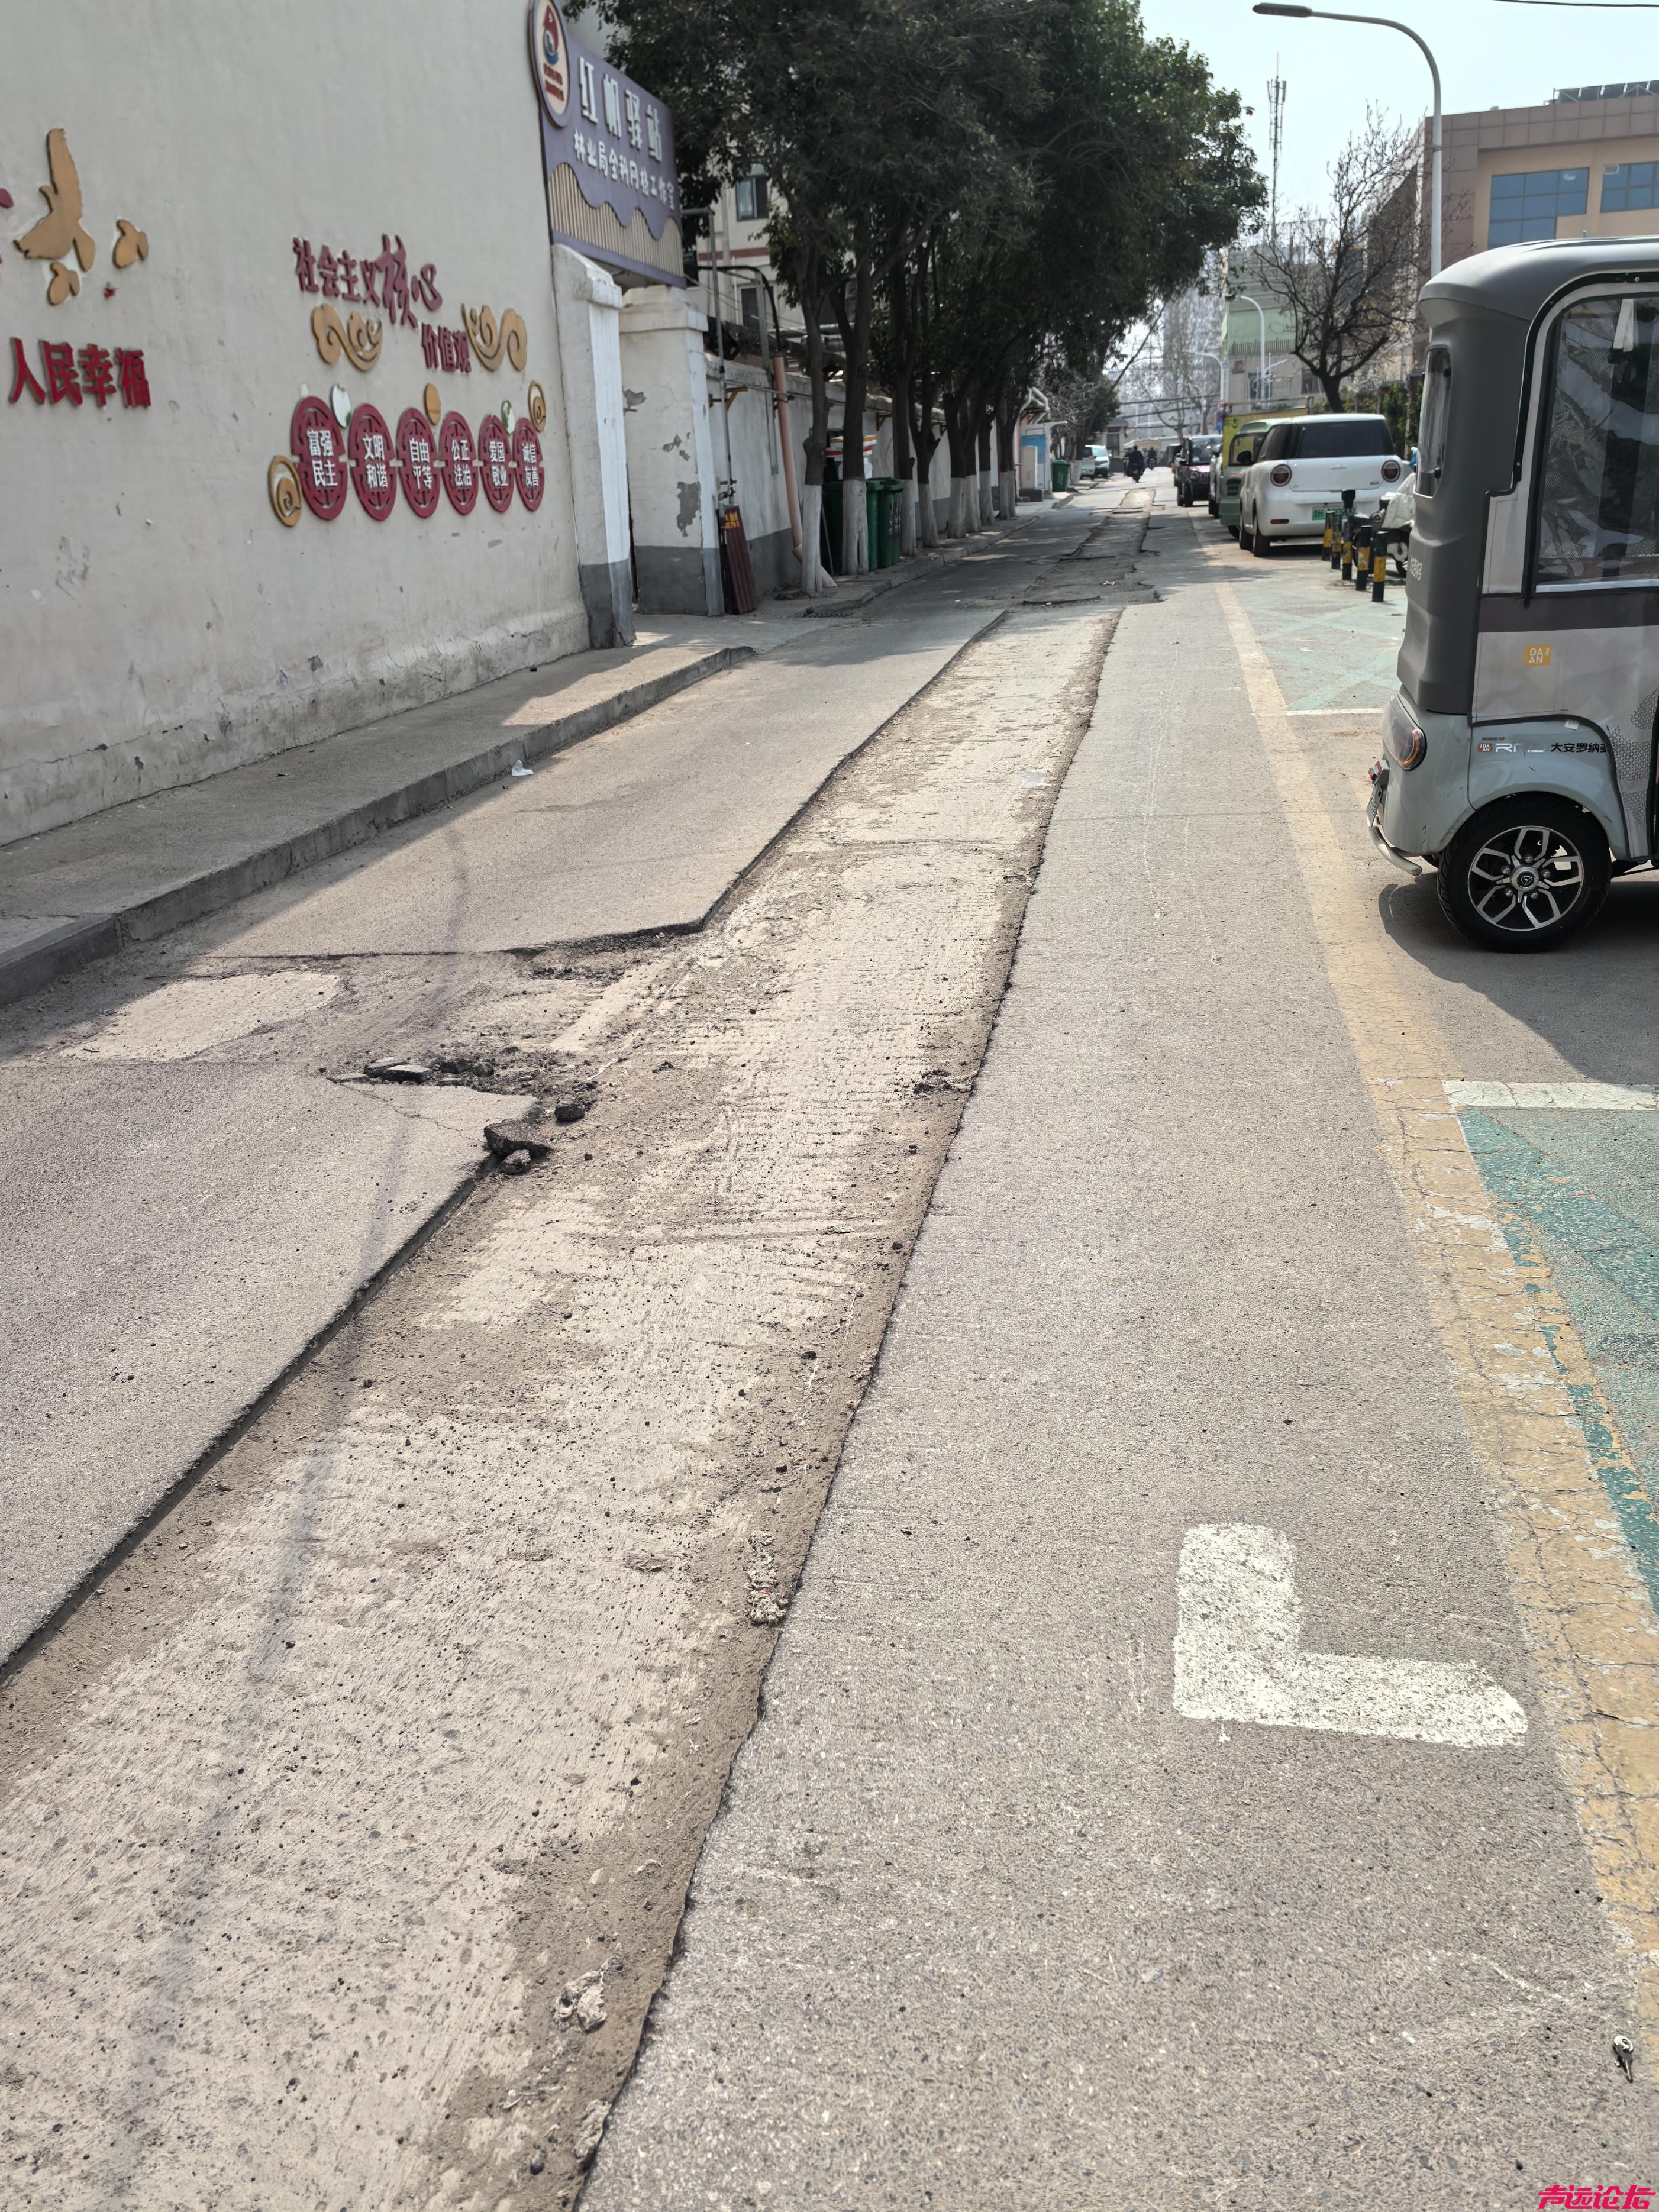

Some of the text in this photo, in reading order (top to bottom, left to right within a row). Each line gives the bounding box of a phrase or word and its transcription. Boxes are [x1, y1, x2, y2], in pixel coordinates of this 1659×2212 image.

[579, 57, 663, 163] 红帆驿站
[293, 234, 443, 329] 社会主义核心
[421, 324, 472, 373] 价值观
[9, 337, 151, 408] 人民幸福
[306, 427, 334, 457] 富强
[362, 434, 385, 461] 文明
[409, 437, 430, 463] 自由
[451, 439, 470, 461] 公正
[489, 440, 505, 463] 爱国
[312, 460, 338, 487] 民主
[366, 463, 388, 489] 和谐
[412, 465, 432, 489] 平等
[454, 464, 472, 487] 法治
[491, 465, 508, 486] 敬业
[1529, 648, 1544, 656] DA
